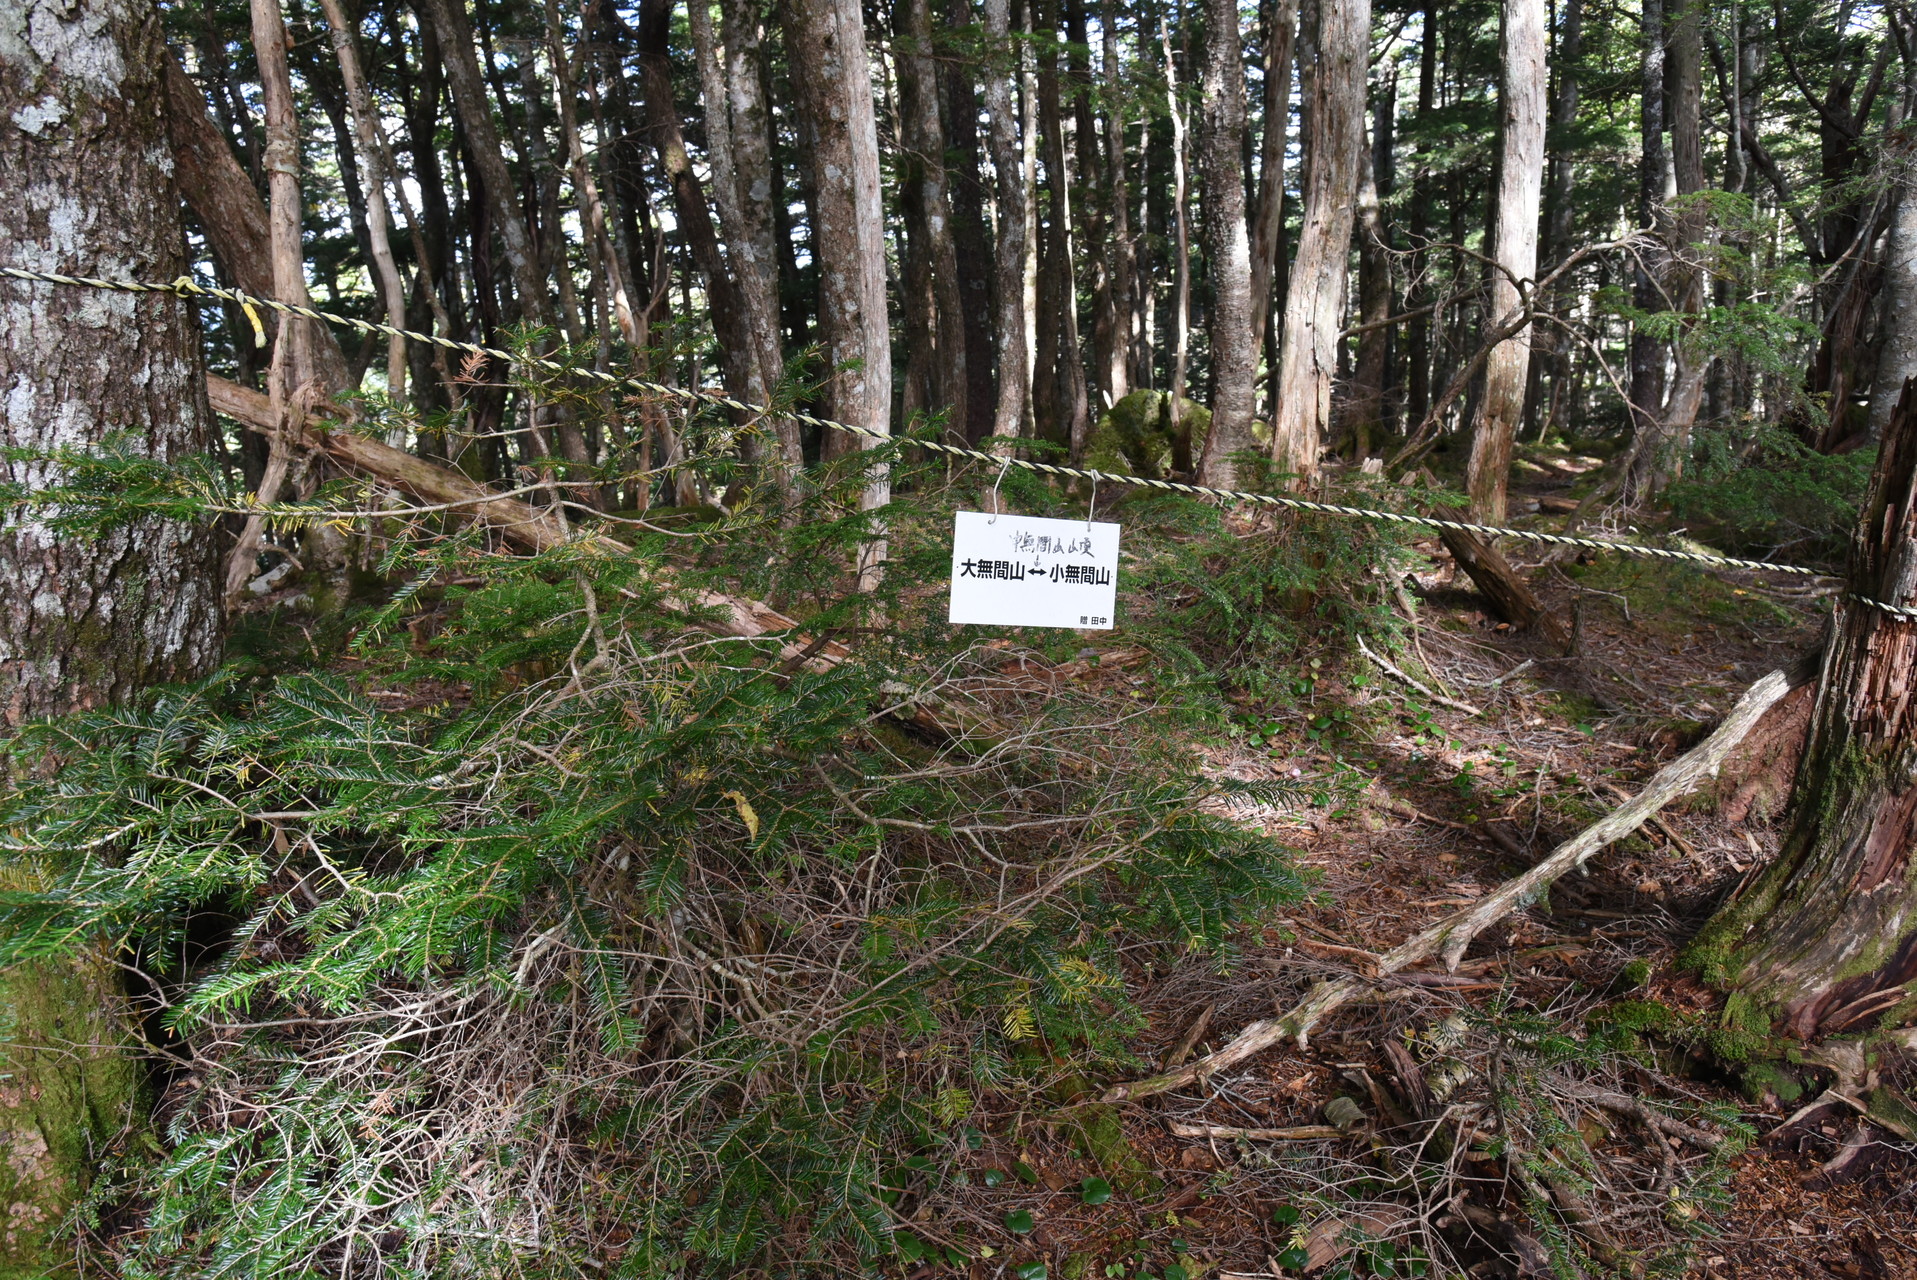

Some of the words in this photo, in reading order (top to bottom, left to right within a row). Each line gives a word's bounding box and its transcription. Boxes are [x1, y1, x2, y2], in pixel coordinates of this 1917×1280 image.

[960, 558, 1025, 581] 大無間山
[1049, 563, 1110, 586] 小無間山
[1091, 616, 1107, 625] 田中
